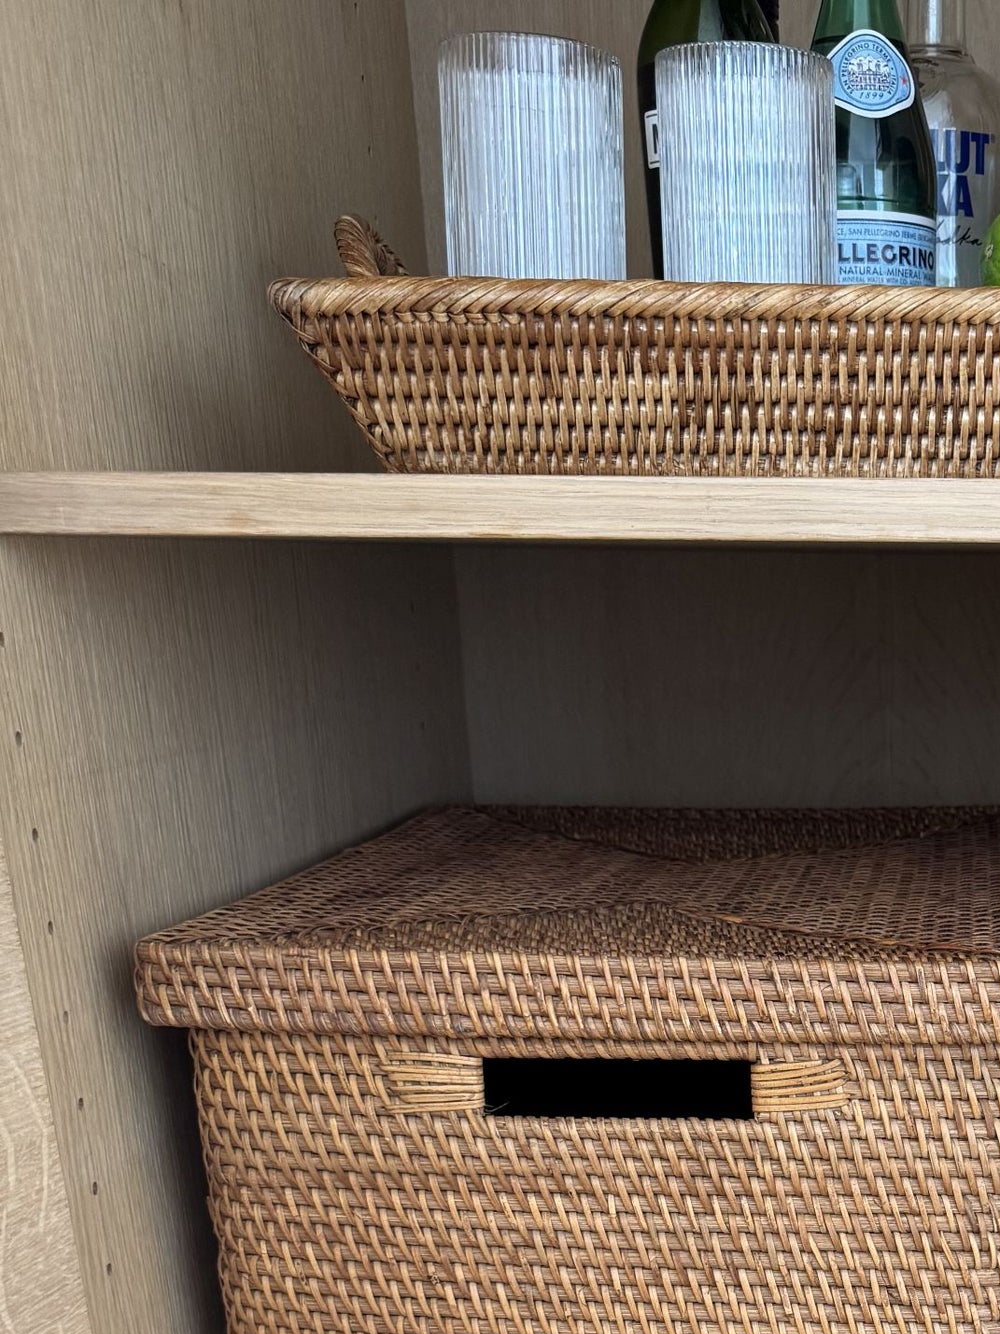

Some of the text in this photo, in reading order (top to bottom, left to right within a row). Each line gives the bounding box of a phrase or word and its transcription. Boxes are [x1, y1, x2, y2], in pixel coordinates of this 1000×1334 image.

[841, 42, 870, 78] PELLEGRINO
[871, 43, 892, 62] TERME
[859, 91, 885, 99] 1899
[838, 266, 884, 276] NATURAL
[886, 268, 922, 280] MINERAL
